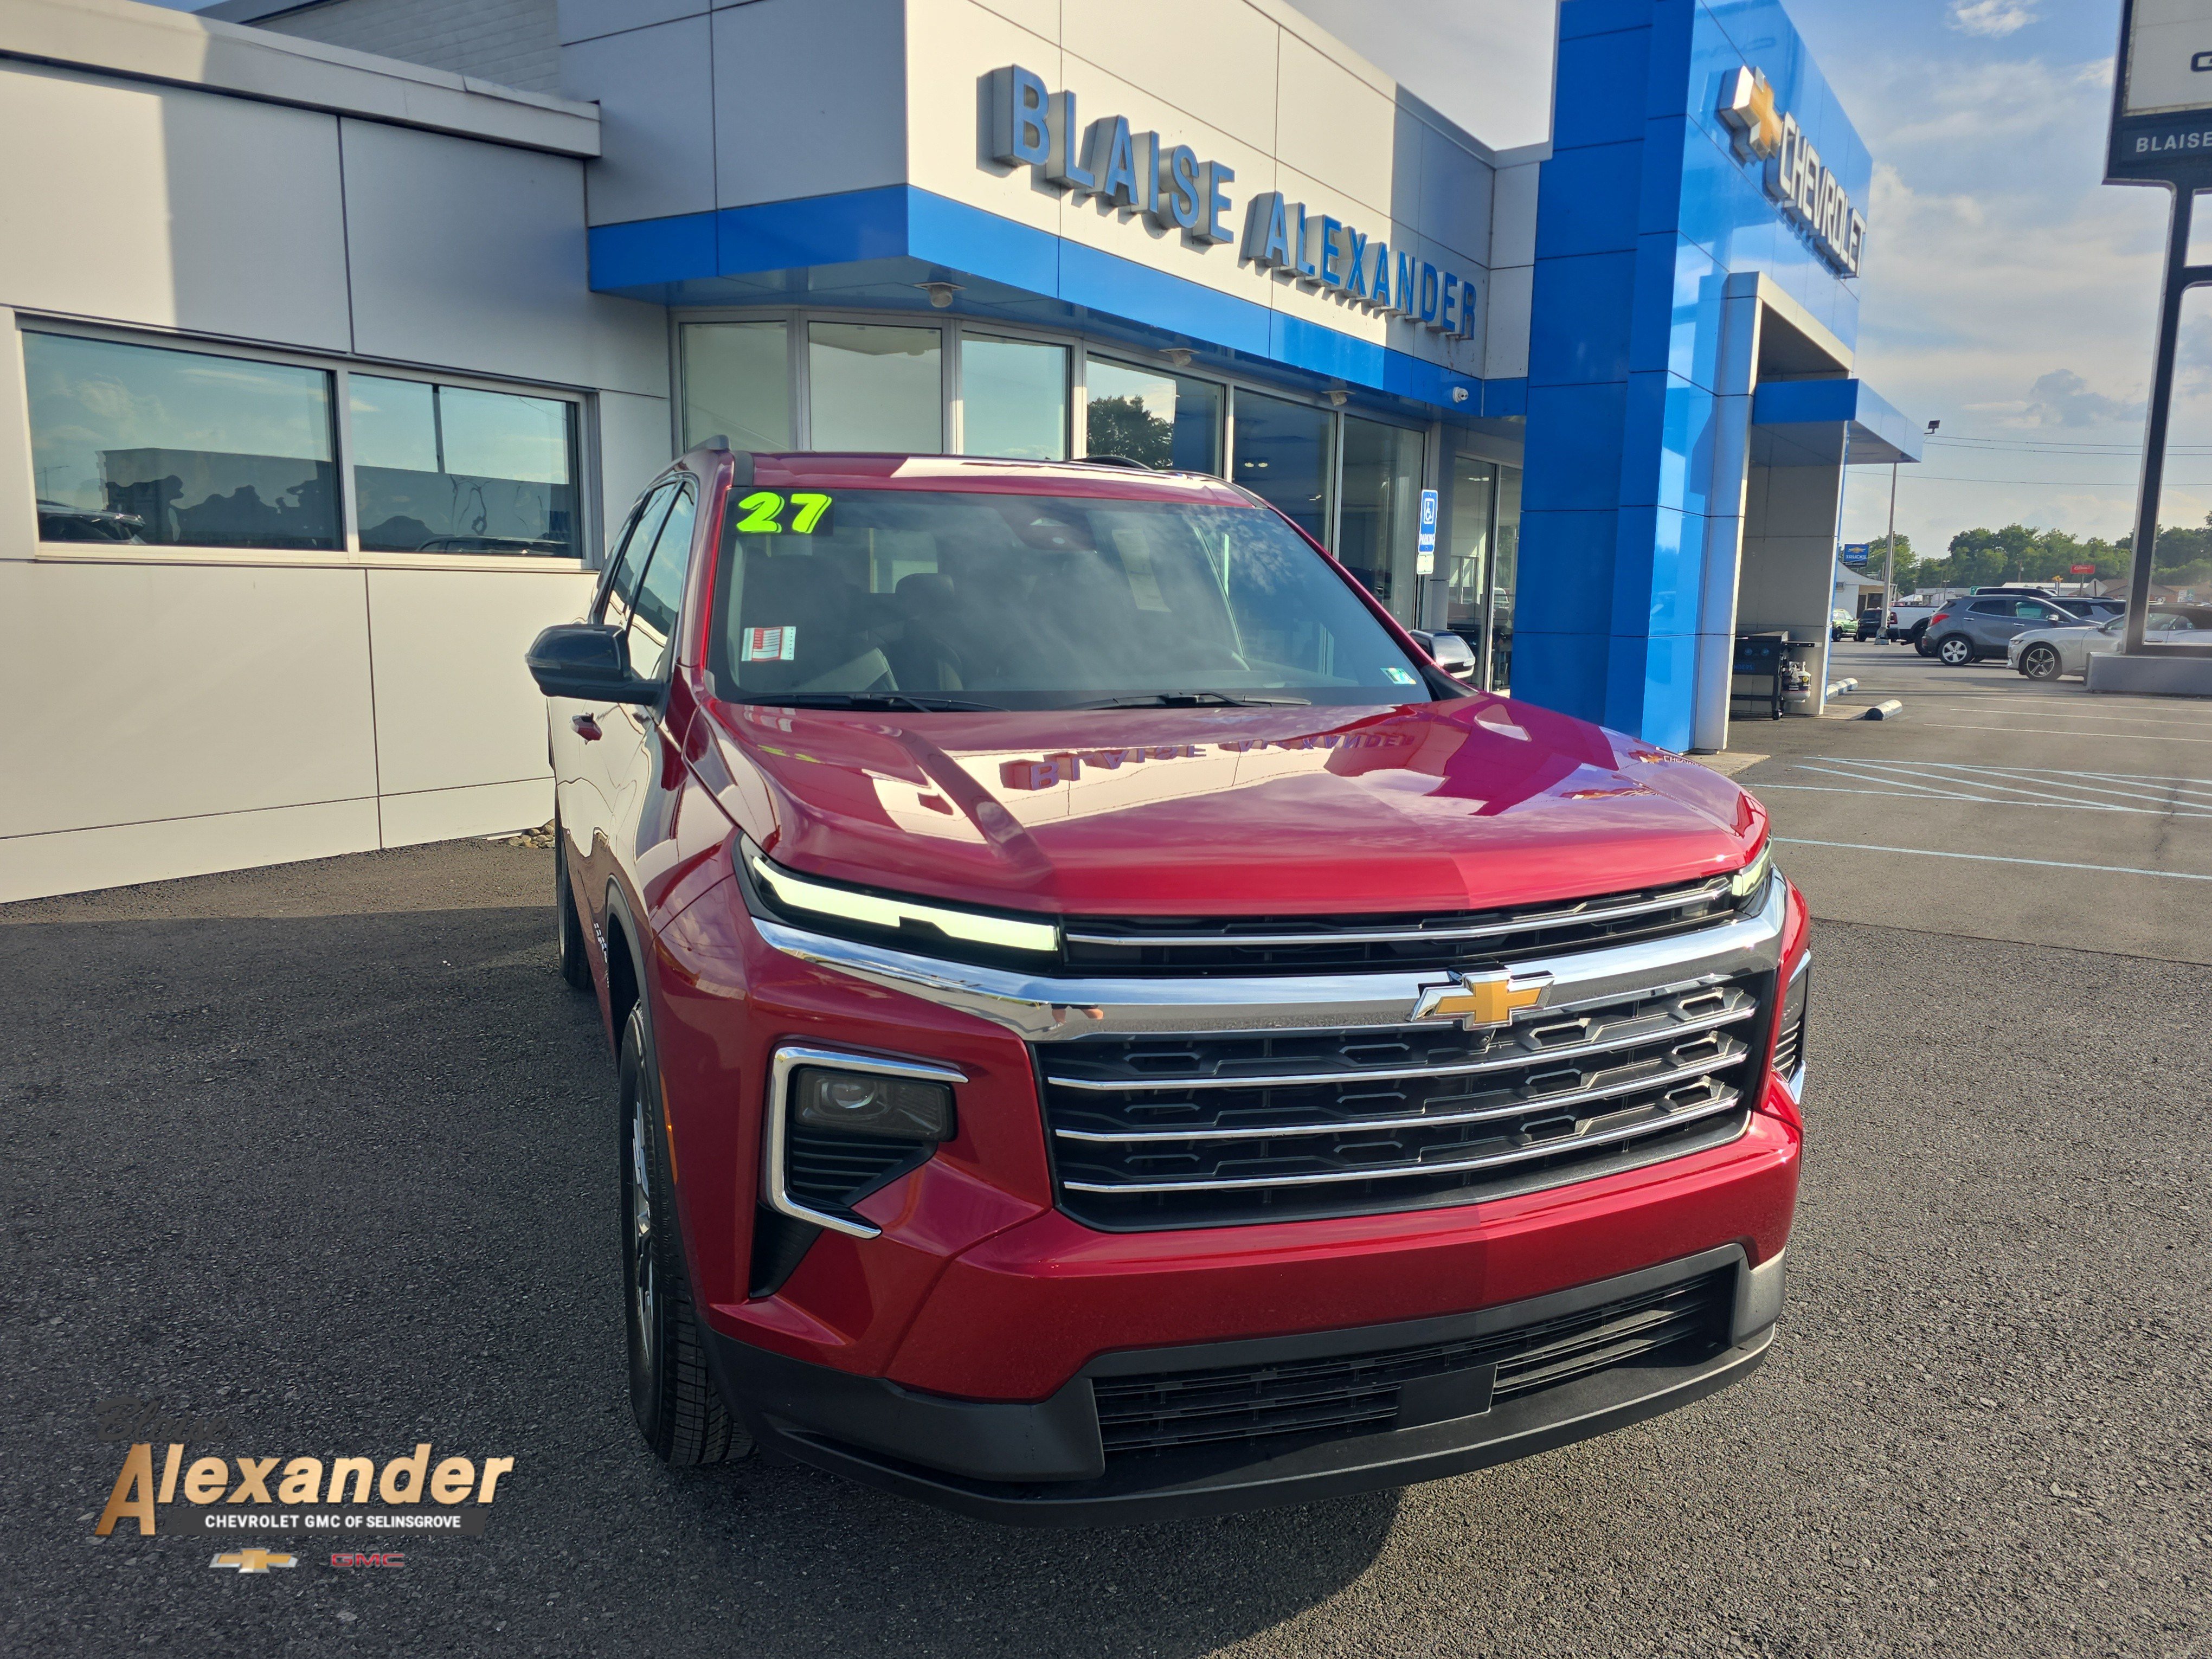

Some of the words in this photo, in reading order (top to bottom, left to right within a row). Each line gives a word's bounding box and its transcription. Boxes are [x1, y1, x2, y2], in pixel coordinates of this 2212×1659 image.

[1778, 111, 1867, 278] CHEVROLET
[2135, 132, 2212, 153] BLAISE
[998, 64, 1234, 245] BLAISE
[1253, 191, 1478, 340] ALEXANDER
[736, 492, 833, 534] 27
